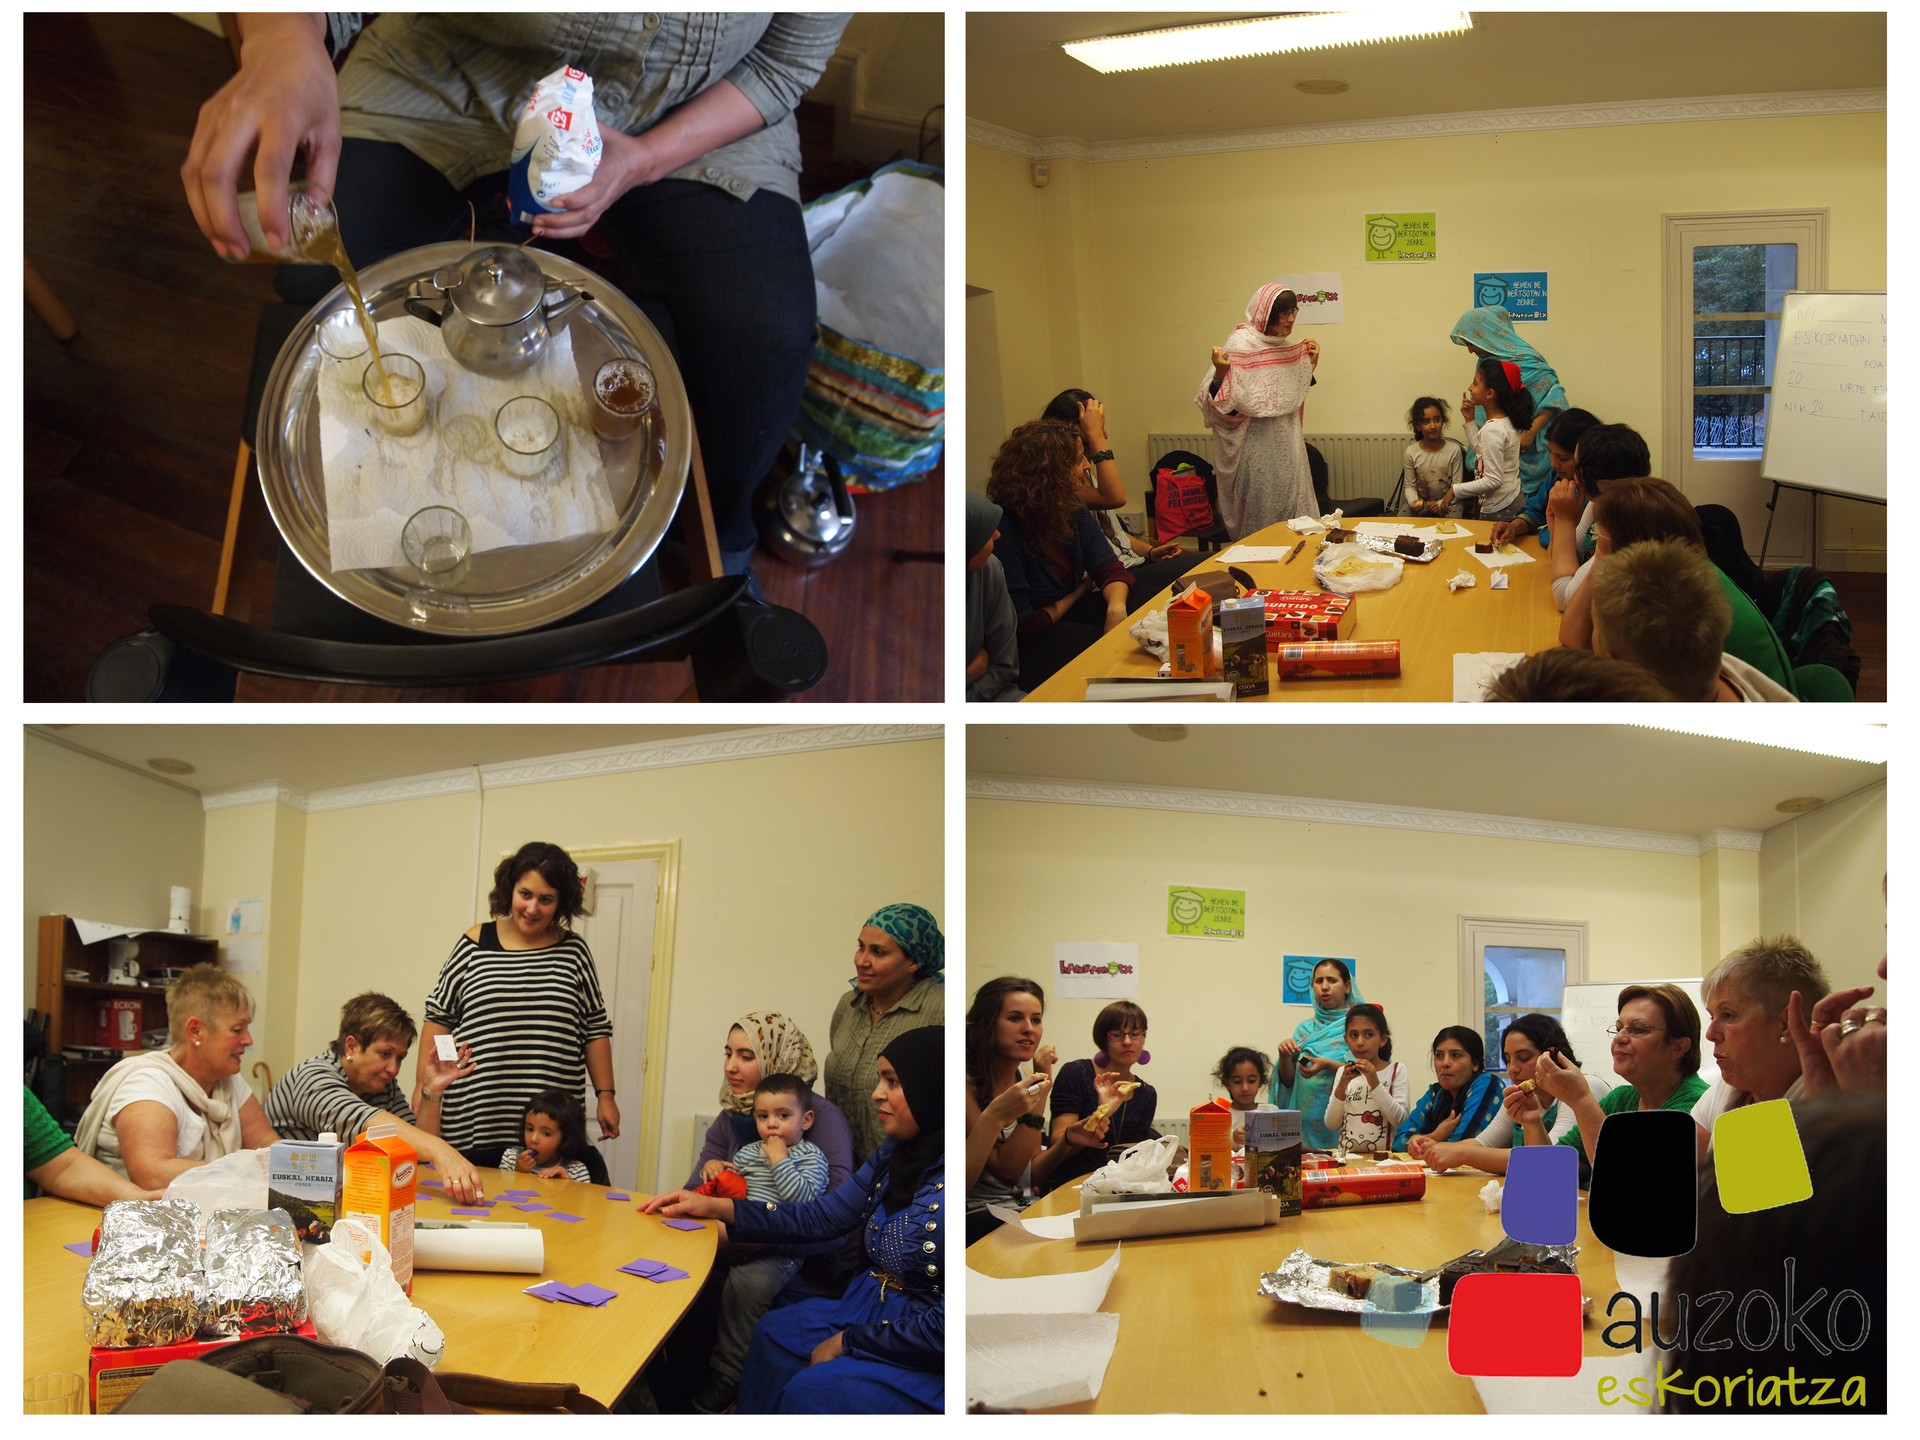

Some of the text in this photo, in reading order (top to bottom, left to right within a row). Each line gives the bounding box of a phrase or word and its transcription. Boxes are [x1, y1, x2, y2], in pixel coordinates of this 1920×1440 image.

[1513, 281, 1542, 289] HEMEN BE
[1787, 369, 1803, 385] 20
[272, 1173, 334, 1183] EUSKAL HERRIA
